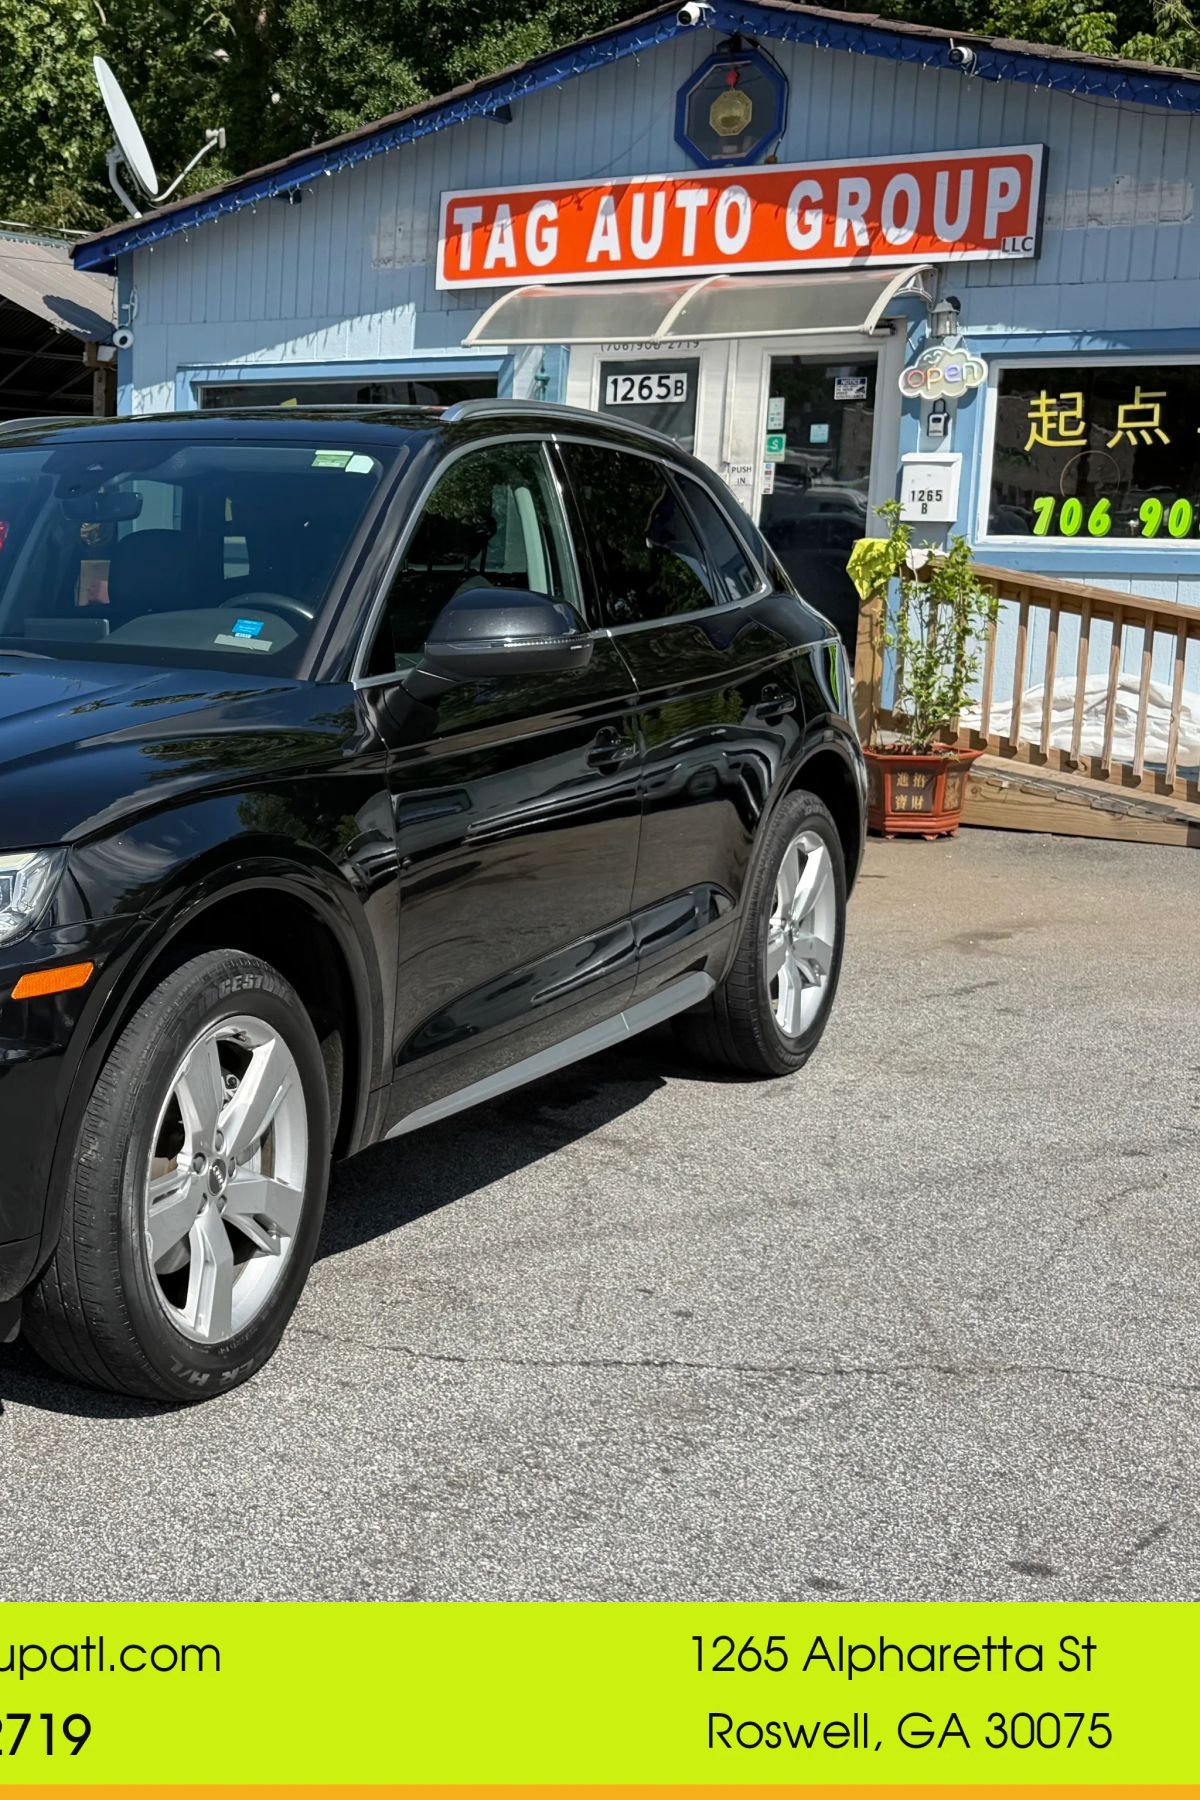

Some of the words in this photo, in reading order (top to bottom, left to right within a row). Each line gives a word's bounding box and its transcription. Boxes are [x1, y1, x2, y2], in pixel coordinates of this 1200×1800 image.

[453, 199, 559, 271] TAG
[585, 184, 752, 263] AUTO
[785, 166, 1022, 251] GROUP
[1002, 237, 1033, 252] LLC
[907, 362, 978, 391] open
[731, 466, 752, 474] PUSH
[911, 490, 943, 502] 1265
[921, 503, 928, 514] B
[1033, 496, 1112, 537] 706
[1139, 497, 1200, 538] 90
